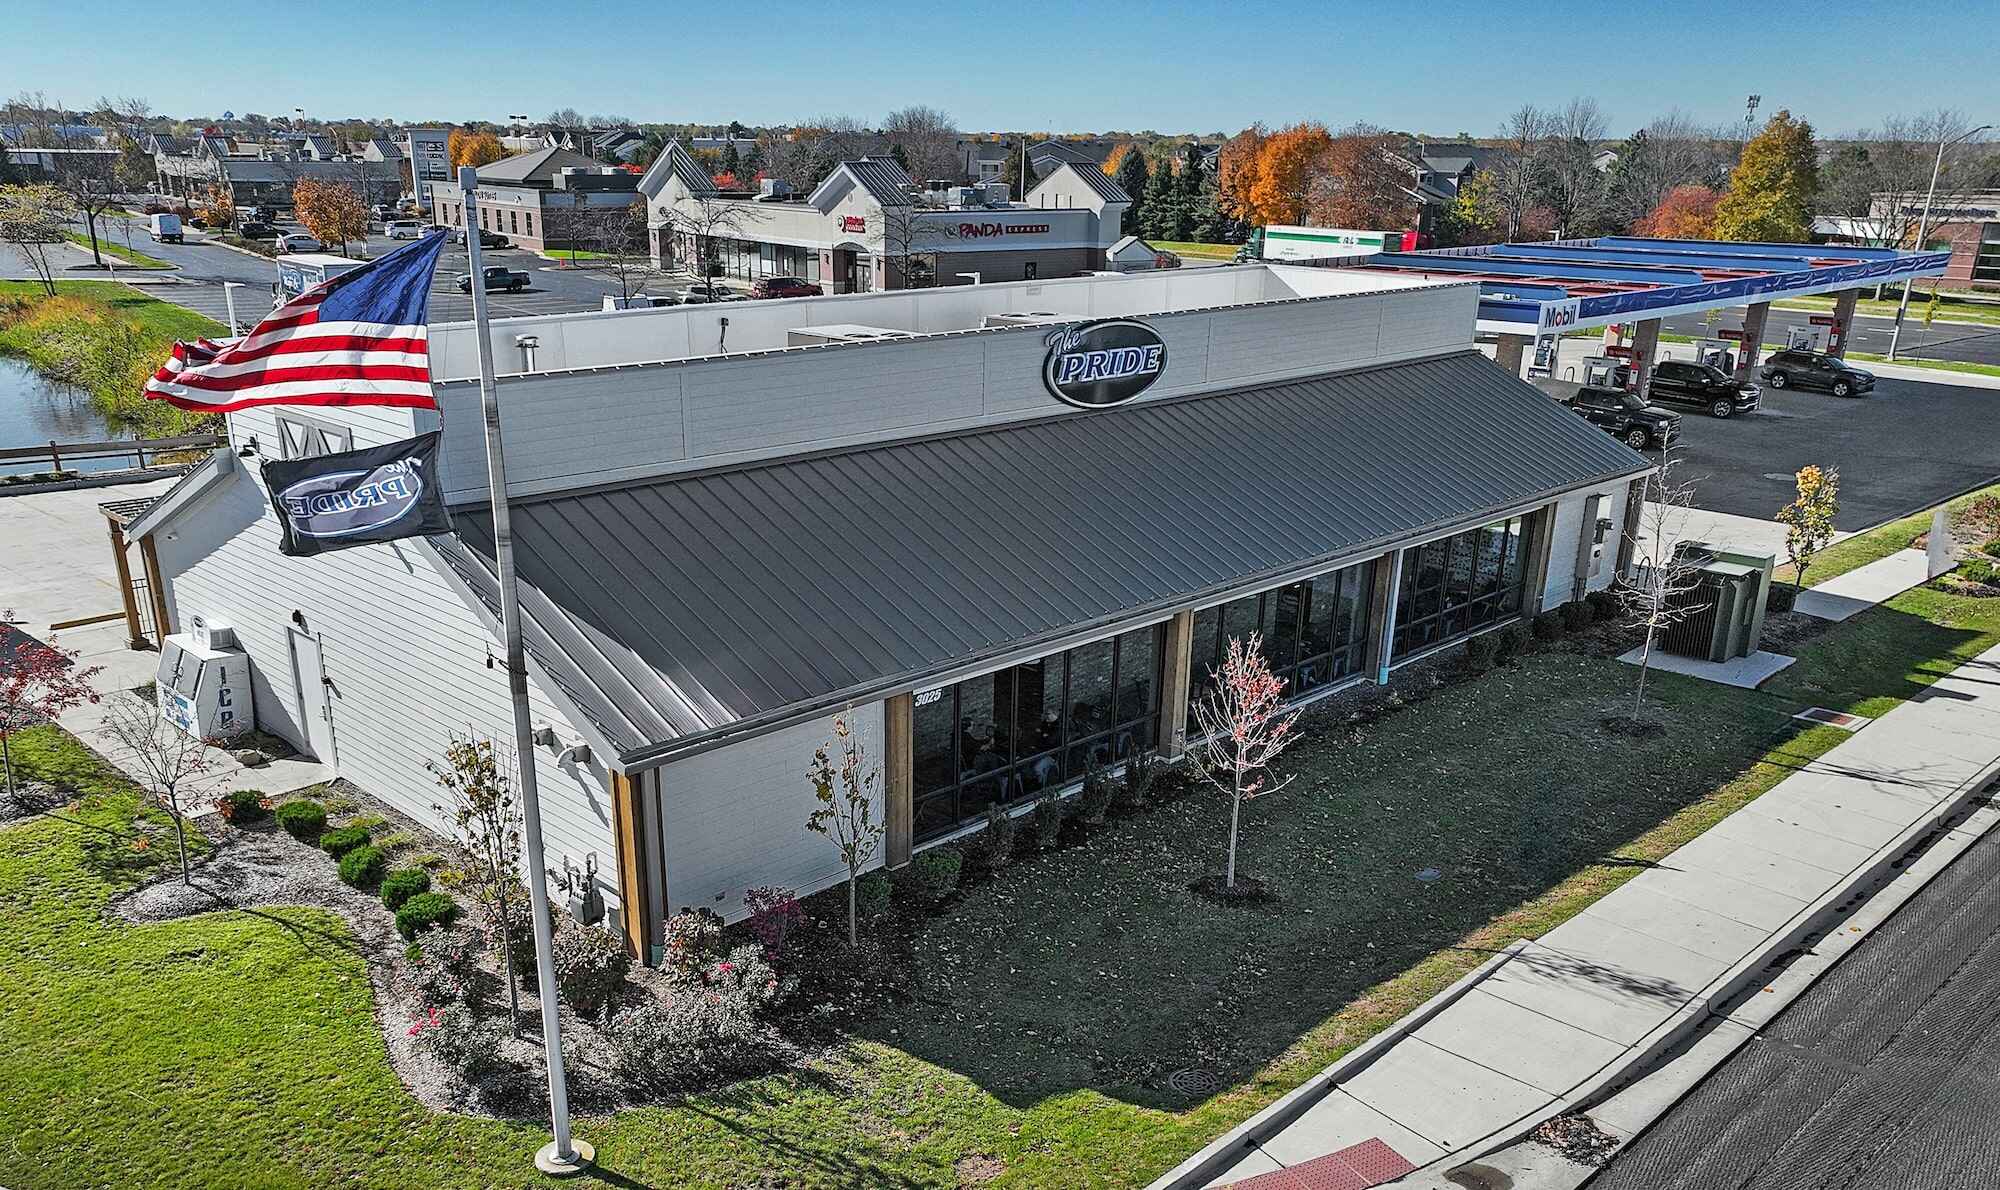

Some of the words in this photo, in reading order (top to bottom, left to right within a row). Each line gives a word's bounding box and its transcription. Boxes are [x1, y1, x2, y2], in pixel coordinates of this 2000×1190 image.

[959, 223, 1004, 238] PANDA
[1007, 225, 1049, 233] EXPRESS
[1544, 305, 1577, 328] Mobil
[1045, 326, 1081, 356] The
[1057, 344, 1163, 385] PRIDE
[914, 689, 943, 707] 3025
